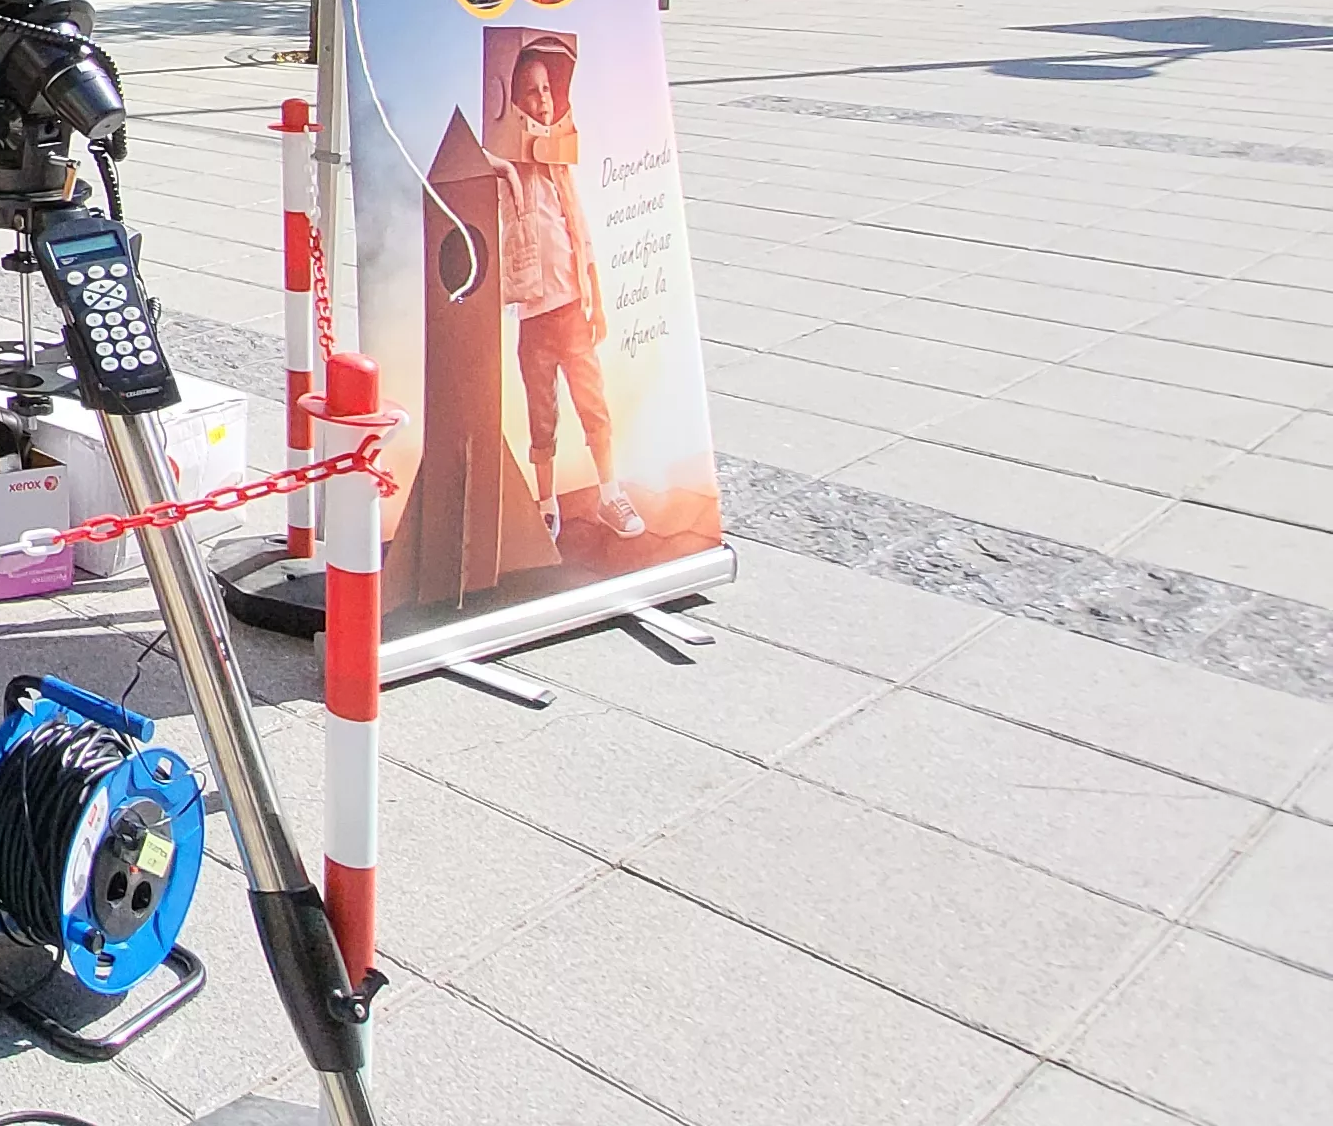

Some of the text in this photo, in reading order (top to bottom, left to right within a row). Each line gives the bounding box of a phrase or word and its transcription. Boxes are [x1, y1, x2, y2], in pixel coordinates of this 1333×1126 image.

[601, 138, 672, 191] Despertando
[606, 192, 666, 228] vocaciones
[615, 266, 668, 311] desde la
[8, 478, 42, 493] xerox
